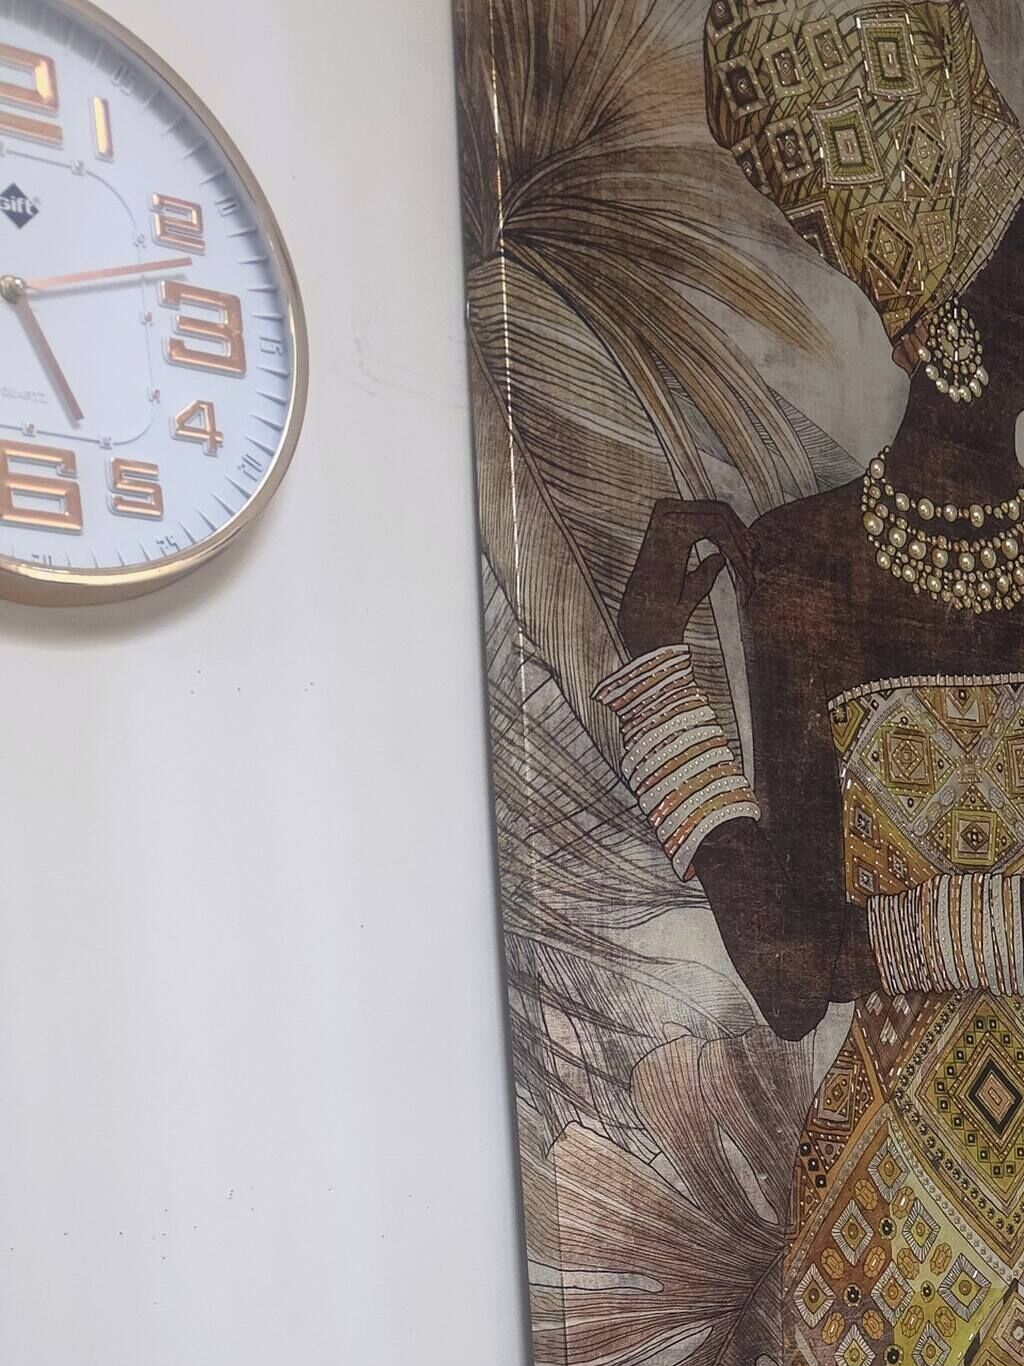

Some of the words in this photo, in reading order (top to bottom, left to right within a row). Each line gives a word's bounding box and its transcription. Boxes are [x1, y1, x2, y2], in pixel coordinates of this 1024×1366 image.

[92, 96, 114, 159] 1
[152, 192, 206, 250] 2
[160, 280, 247, 376] 3
[173, 400, 223, 455] 4
[0, 440, 83, 533] 6
[110, 458, 164, 521] 5
